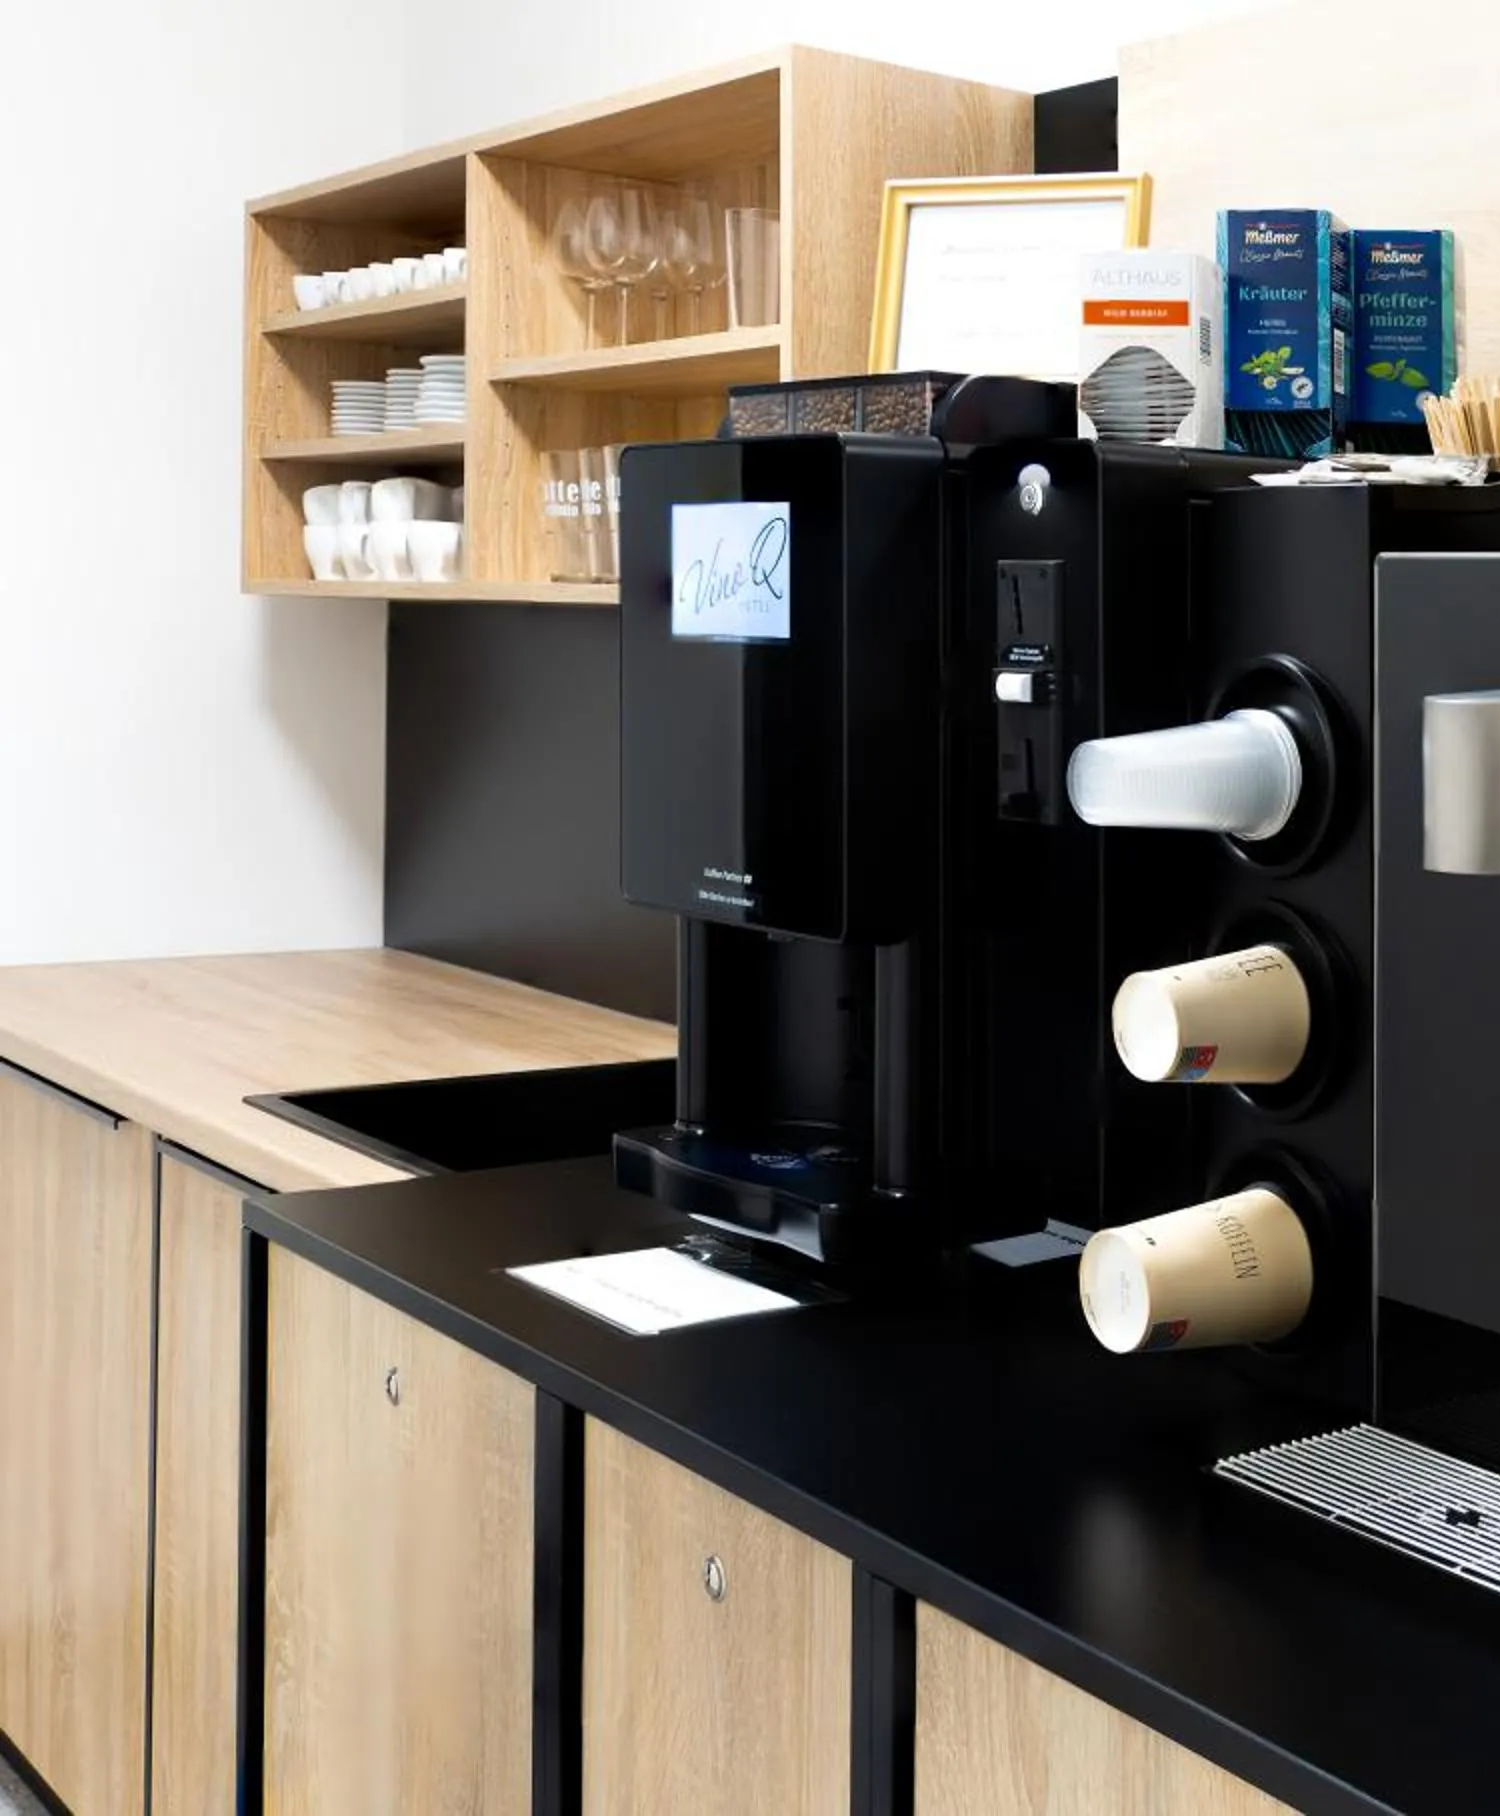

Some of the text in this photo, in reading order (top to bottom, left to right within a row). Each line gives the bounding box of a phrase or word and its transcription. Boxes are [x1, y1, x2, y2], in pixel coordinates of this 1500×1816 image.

[1245, 229, 1301, 245] Meßmer
[1371, 249, 1425, 265] Meßmer
[1091, 268, 1183, 288] ALTHAUS
[1239, 286, 1308, 301] Kräuter
[1360, 291, 1437, 308] Pfeffer-
[1369, 312, 1428, 327] minze
[679, 517, 787, 615] Vino Q
[1216, 1215, 1261, 1279] KOFFEIN
